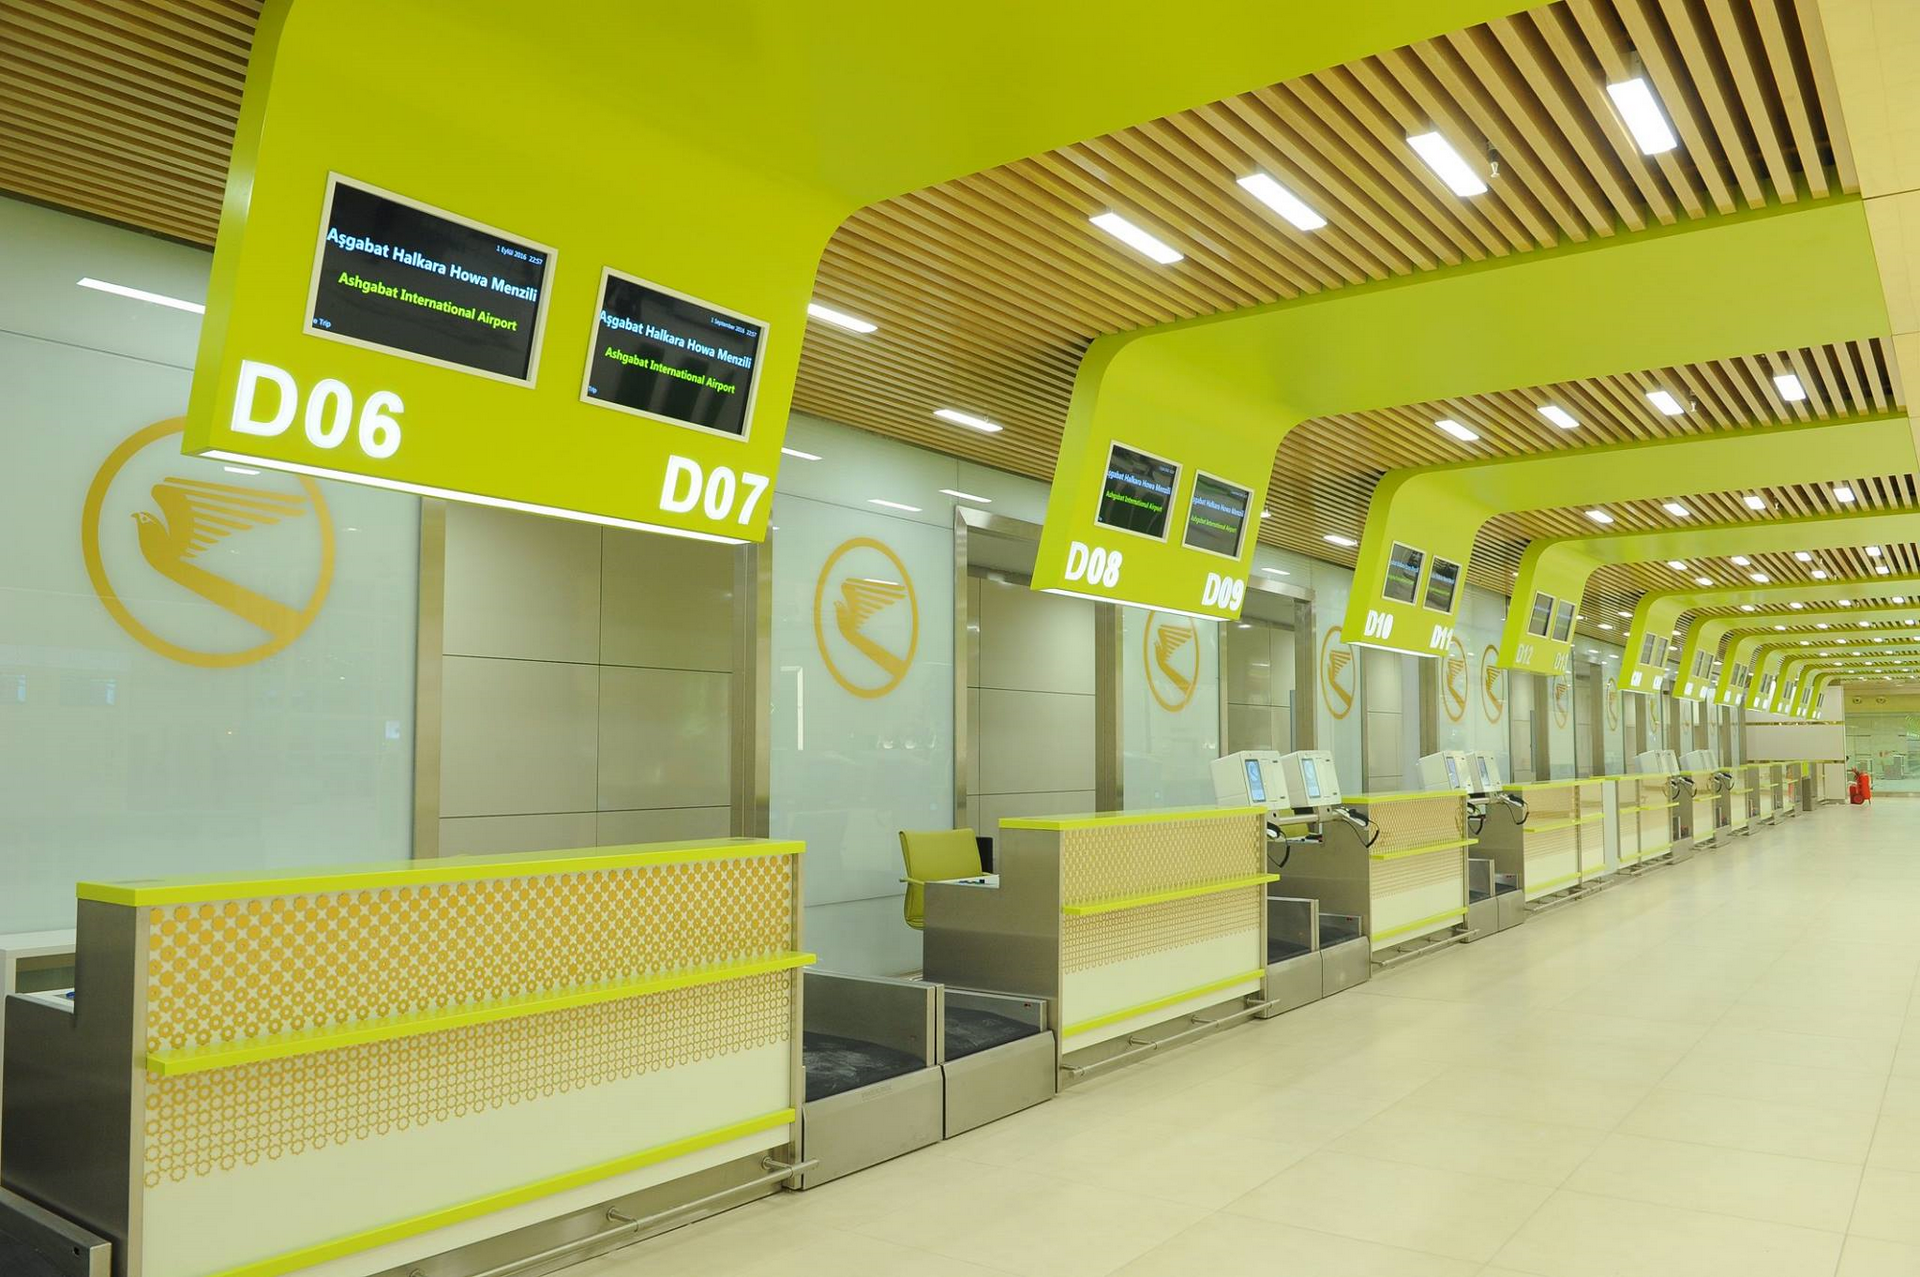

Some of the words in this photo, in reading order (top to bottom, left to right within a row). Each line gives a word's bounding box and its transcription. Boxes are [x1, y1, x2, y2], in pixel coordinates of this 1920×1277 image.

[326, 228, 389, 258] Aşgabat
[392, 247, 446, 275] Halkara
[450, 264, 488, 288] Howa
[491, 276, 538, 302] Menzili
[338, 271, 398, 299] Ashgabat
[400, 289, 475, 320] International
[477, 310, 517, 332] Airport
[645, 324, 684, 348] Halkara
[687, 338, 715, 357] Howa
[717, 348, 752, 369] Menzili
[605, 347, 649, 369] Ashgabat
[650, 360, 706, 385] International
[706, 377, 735, 394] Airport
[230, 359, 404, 459] D06
[659, 454, 770, 526] D07
[1065, 541, 1122, 588] D08
[1201, 572, 1244, 612] D09
[1364, 609, 1394, 640] D10
[1429, 624, 1454, 651] D11
[1515, 643, 1534, 665] D12
